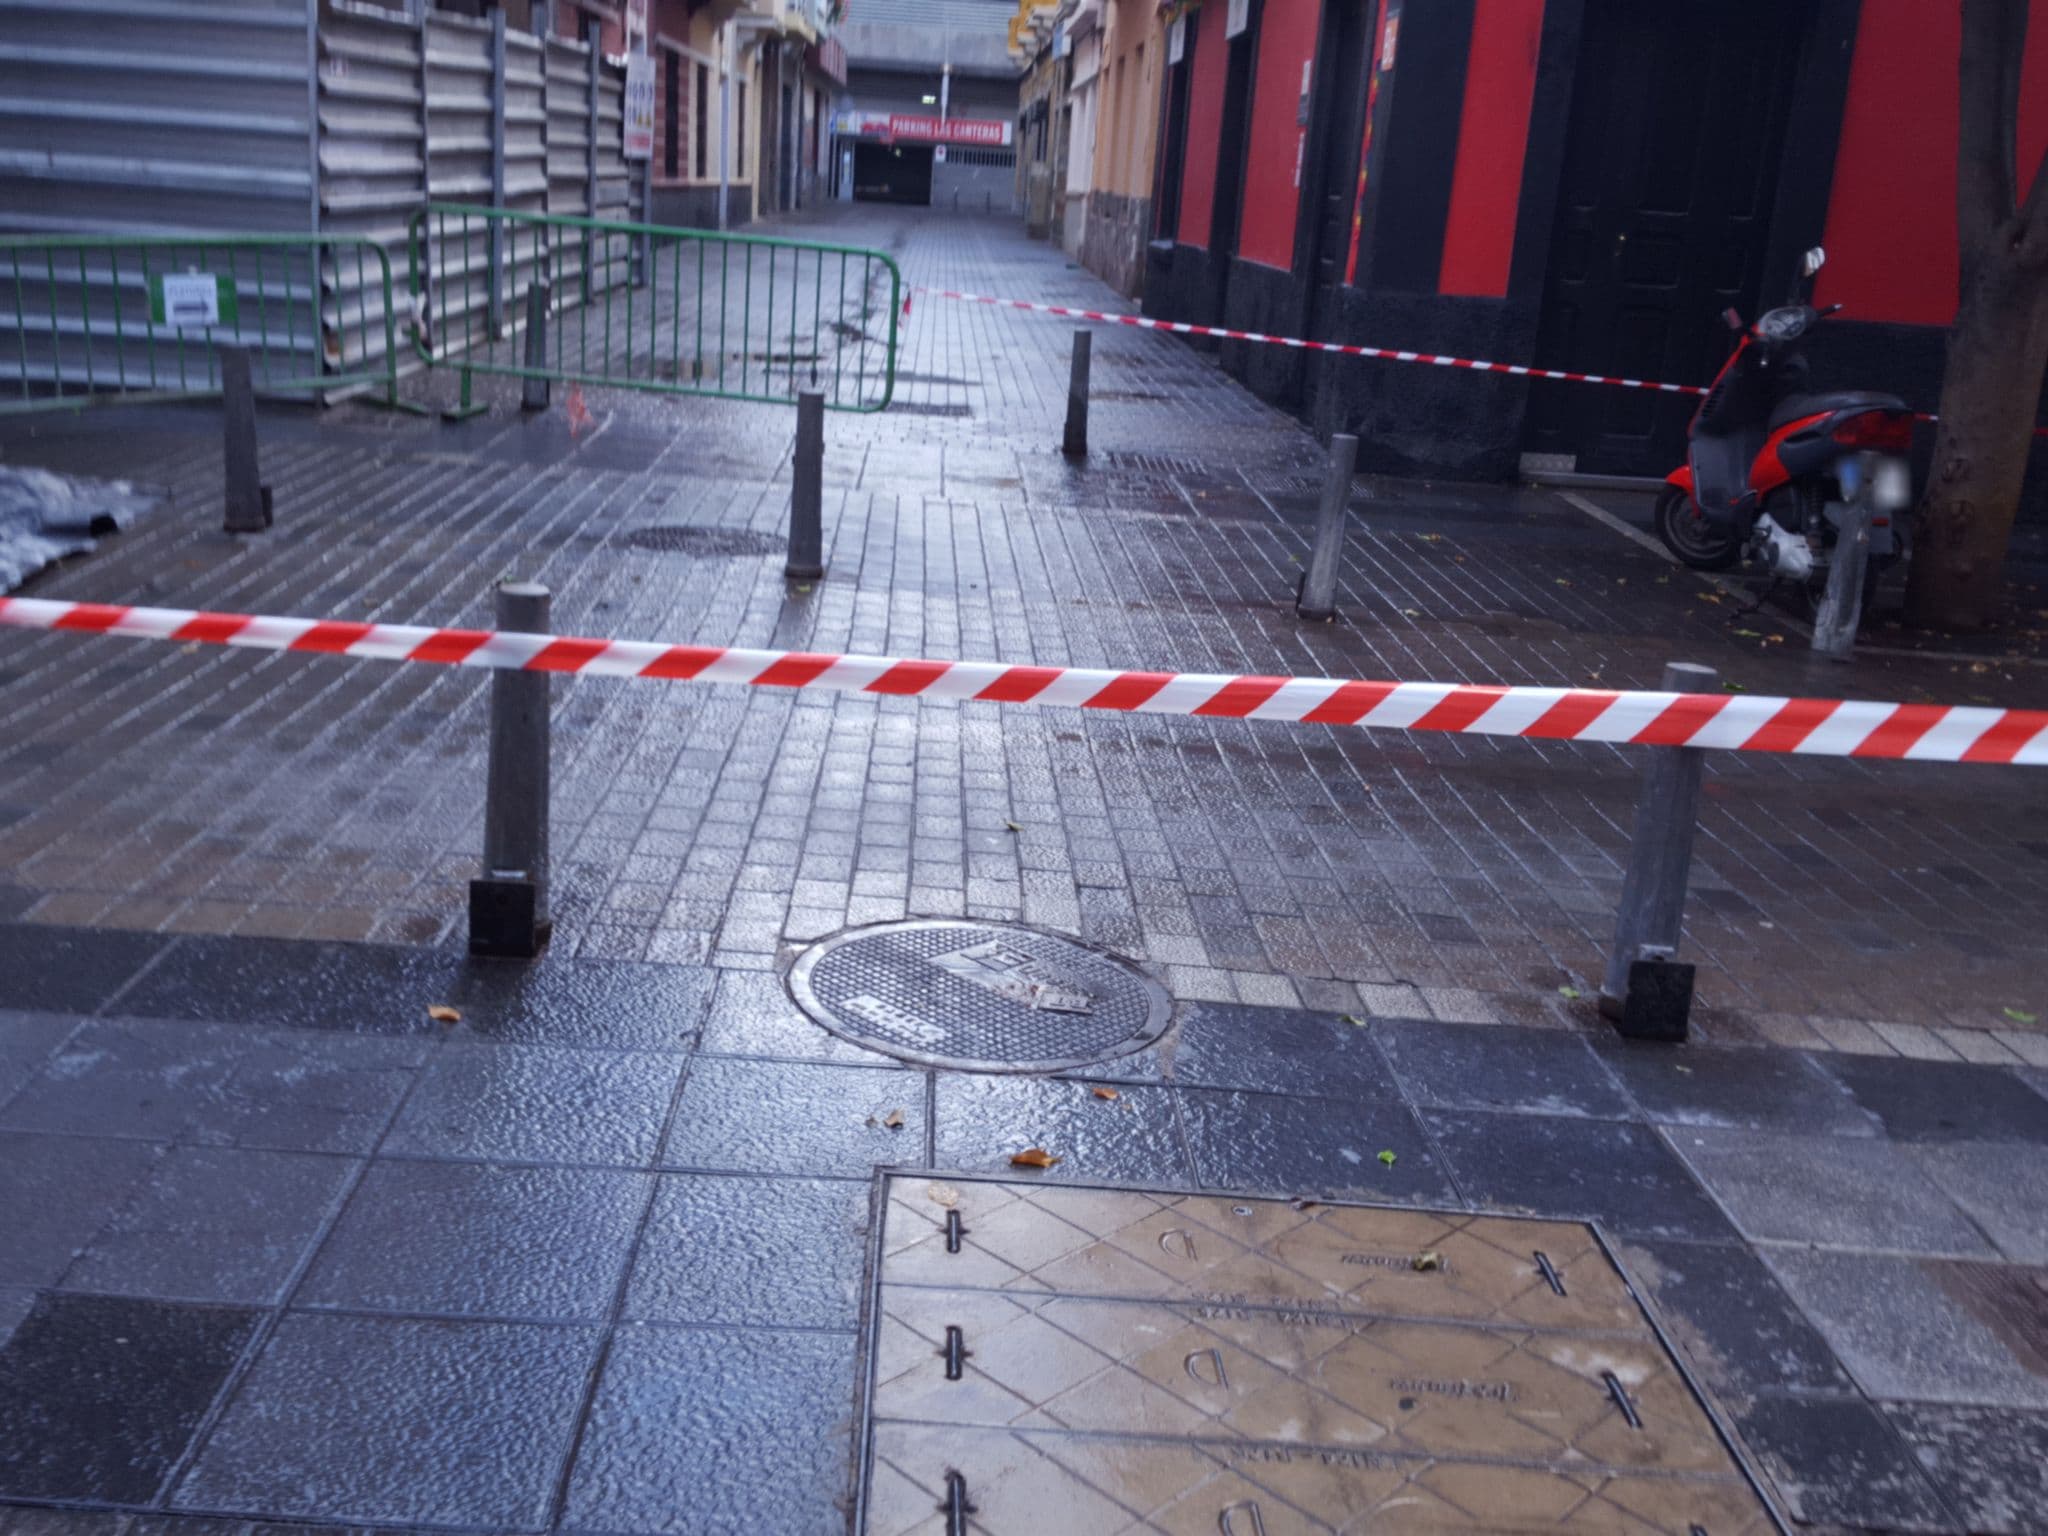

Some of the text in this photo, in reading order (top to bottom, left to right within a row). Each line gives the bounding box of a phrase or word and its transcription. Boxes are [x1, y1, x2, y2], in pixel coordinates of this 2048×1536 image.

[892, 119, 1001, 141] PARKING LAS CANTERAS
